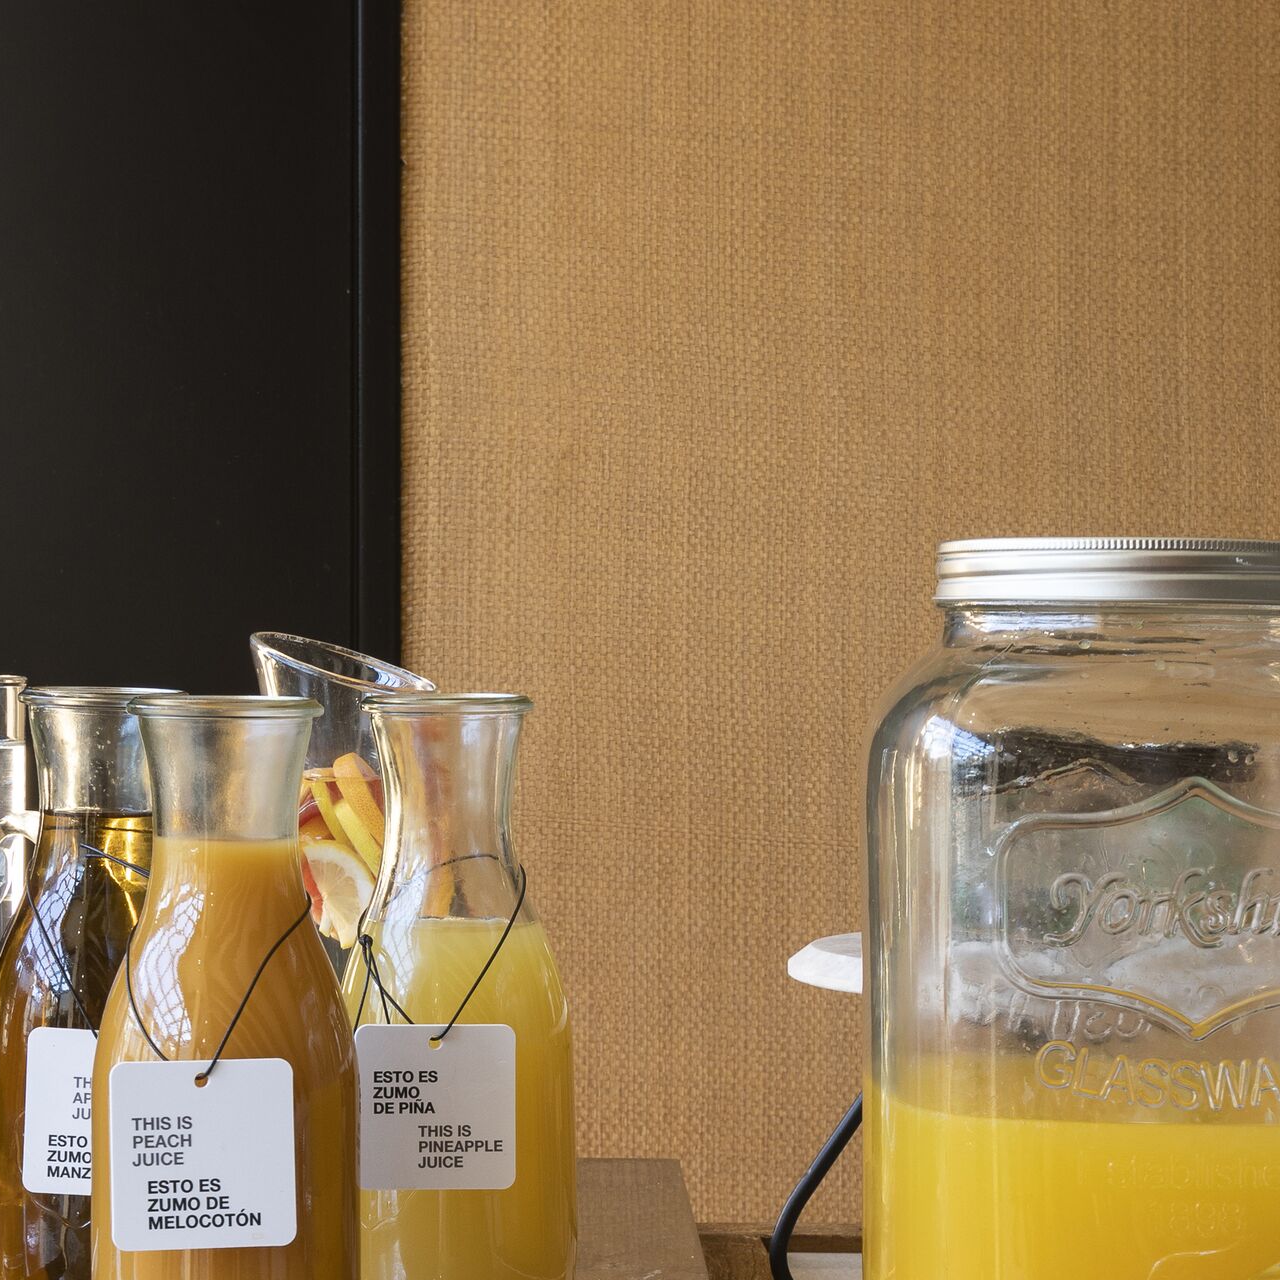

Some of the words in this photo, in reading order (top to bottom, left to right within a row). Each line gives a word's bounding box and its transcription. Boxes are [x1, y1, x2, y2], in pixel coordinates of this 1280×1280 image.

[374, 1071, 414, 1083] ESTO
[419, 1070, 438, 1083] ES
[373, 1086, 420, 1099] ZUMO
[374, 1102, 394, 1114] DE
[399, 1098, 435, 1114] PIÑA
[131, 1116, 171, 1131] THIS
[177, 1116, 193, 1130] IS
[418, 1125, 453, 1137] THIS
[458, 1125, 471, 1137] IS
[48, 1134, 88, 1148] ESTO
[133, 1134, 192, 1149] PEACH
[419, 1140, 503, 1153] PINEAPPLE
[47, 1150, 92, 1164] ZUMO
[132, 1152, 184, 1167] JUICE
[418, 1156, 463, 1169] JUICE
[148, 1179, 193, 1194] ESTO
[199, 1178, 221, 1192] ES
[147, 1197, 200, 1212] ZUMO
[206, 1196, 230, 1210] DE
[148, 1209, 261, 1230] MELOCOTÓN
